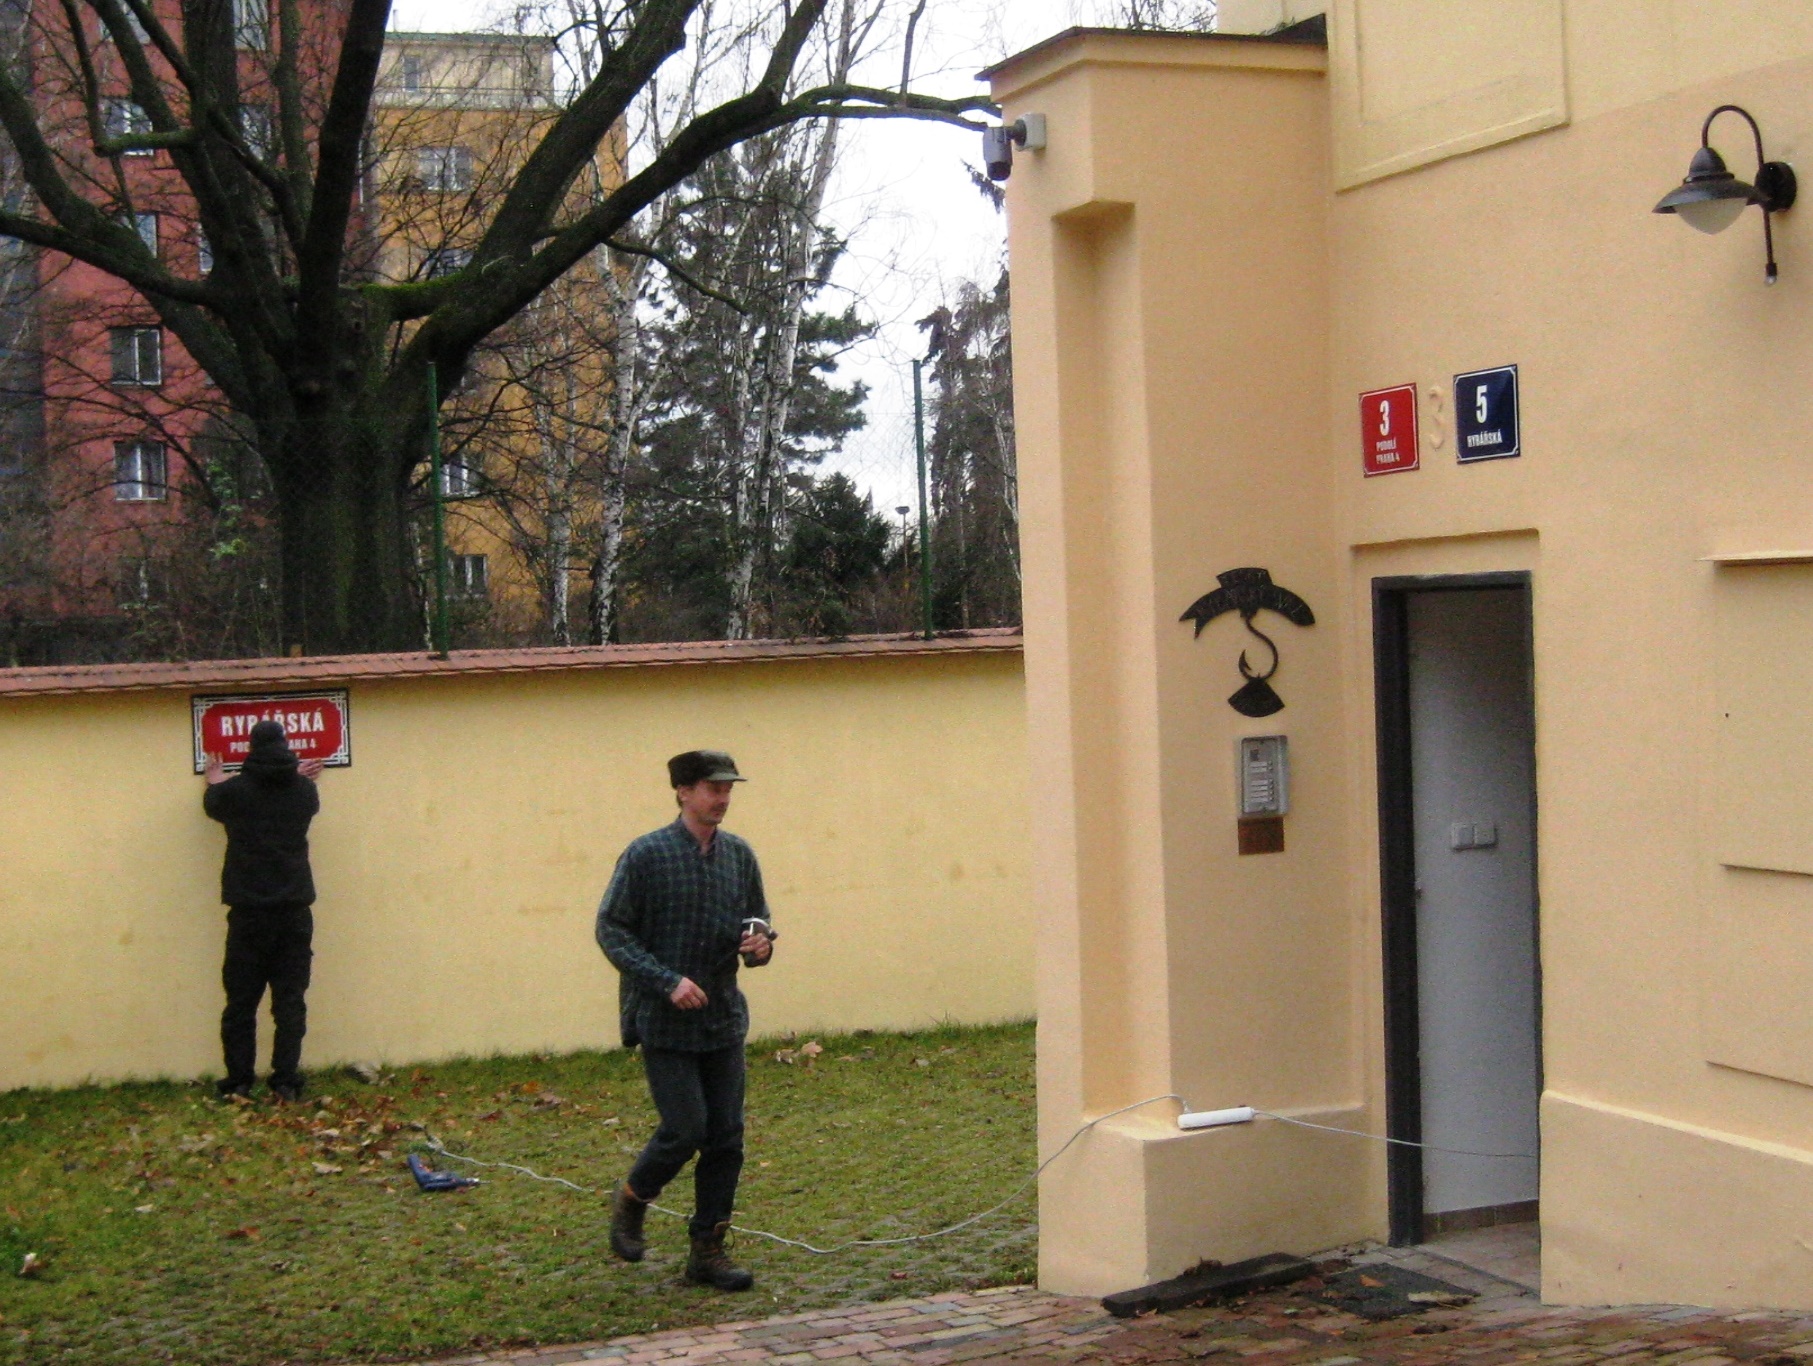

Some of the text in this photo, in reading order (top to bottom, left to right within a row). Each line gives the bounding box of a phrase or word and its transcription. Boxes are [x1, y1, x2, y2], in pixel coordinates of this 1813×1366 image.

[1379, 400, 1390, 436] 3
[1476, 384, 1488, 424] 5
[310, 738, 317, 749] 4
